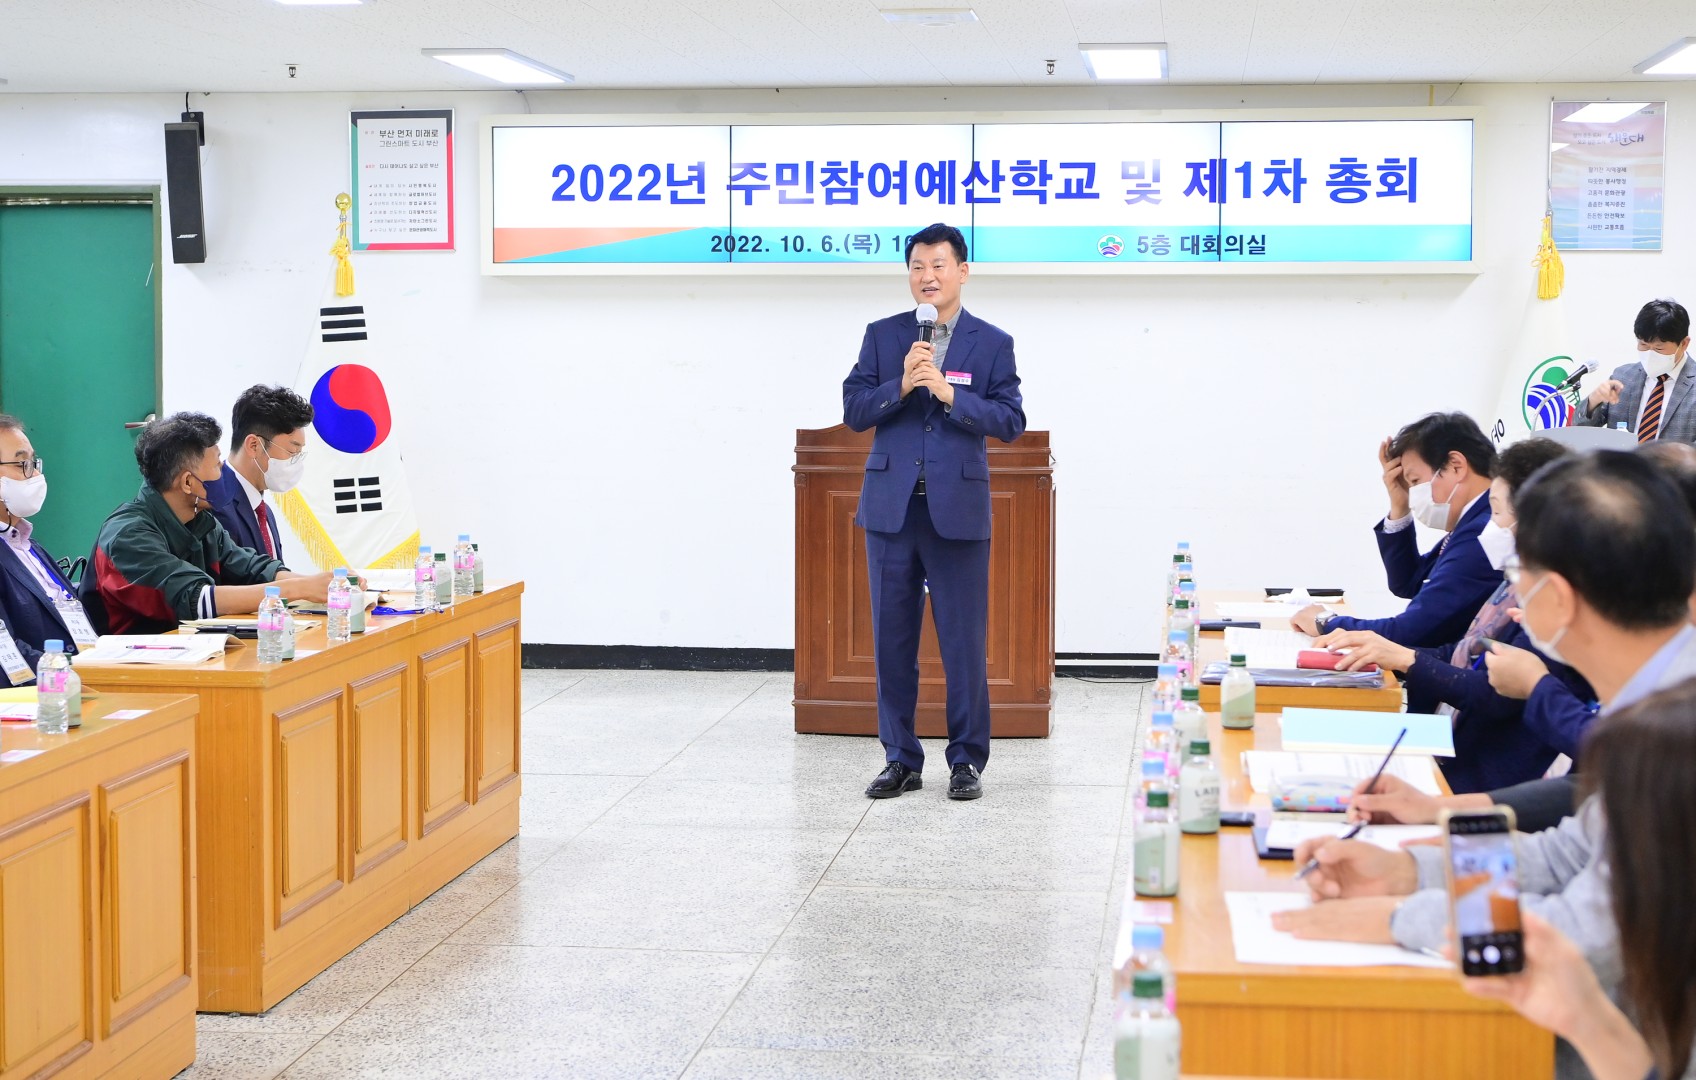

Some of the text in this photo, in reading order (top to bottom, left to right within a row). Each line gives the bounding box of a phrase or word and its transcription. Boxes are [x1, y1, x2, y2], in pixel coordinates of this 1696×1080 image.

[379, 129, 395, 139] 부산
[397, 129, 413, 138] 먼저
[415, 129, 439, 138] 미래로
[551, 157, 1419, 206] 2022년 주민참여예산학교 및 제1차 총회
[711, 235, 770, 253] 2022.
[780, 235, 812, 253] 10.
[821, 233, 881, 255] 6.(목)
[1136, 234, 1267, 256] 5층 대회의실
